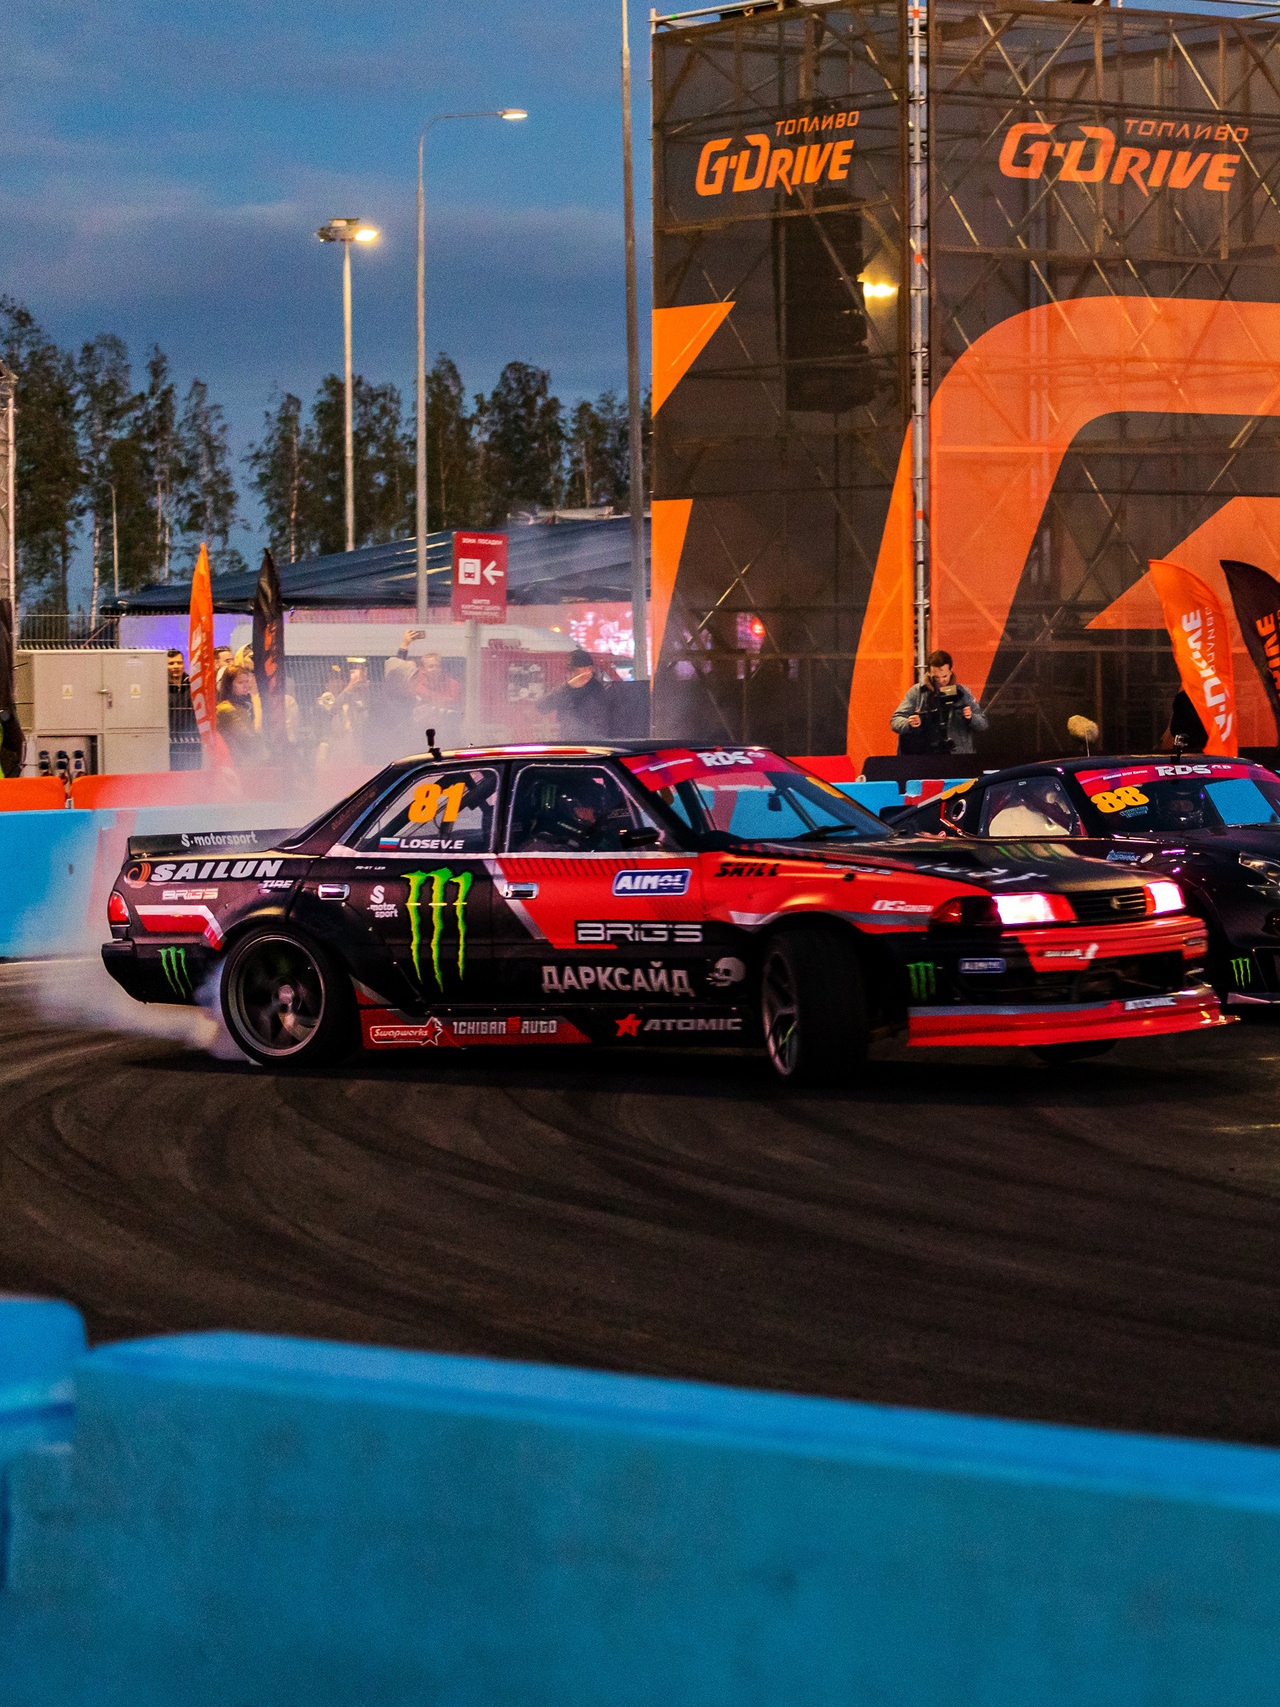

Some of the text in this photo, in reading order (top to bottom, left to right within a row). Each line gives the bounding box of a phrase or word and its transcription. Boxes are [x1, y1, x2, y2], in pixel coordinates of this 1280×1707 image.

[775, 110, 860, 137] ТОПЛИВО
[1124, 119, 1250, 142] ТОПЛИВО
[697, 751, 754, 767] RDS
[1154, 764, 1212, 777] RDS
[407, 782, 466, 824] 81
[1091, 786, 1150, 814] 88
[150, 860, 284, 882] SAILUN
[369, 885, 386, 904] S
[374, 909, 399, 919] sport
[541, 961, 697, 998] ДАРКСАЙД
[642, 1018, 743, 1031] ATOMIC
